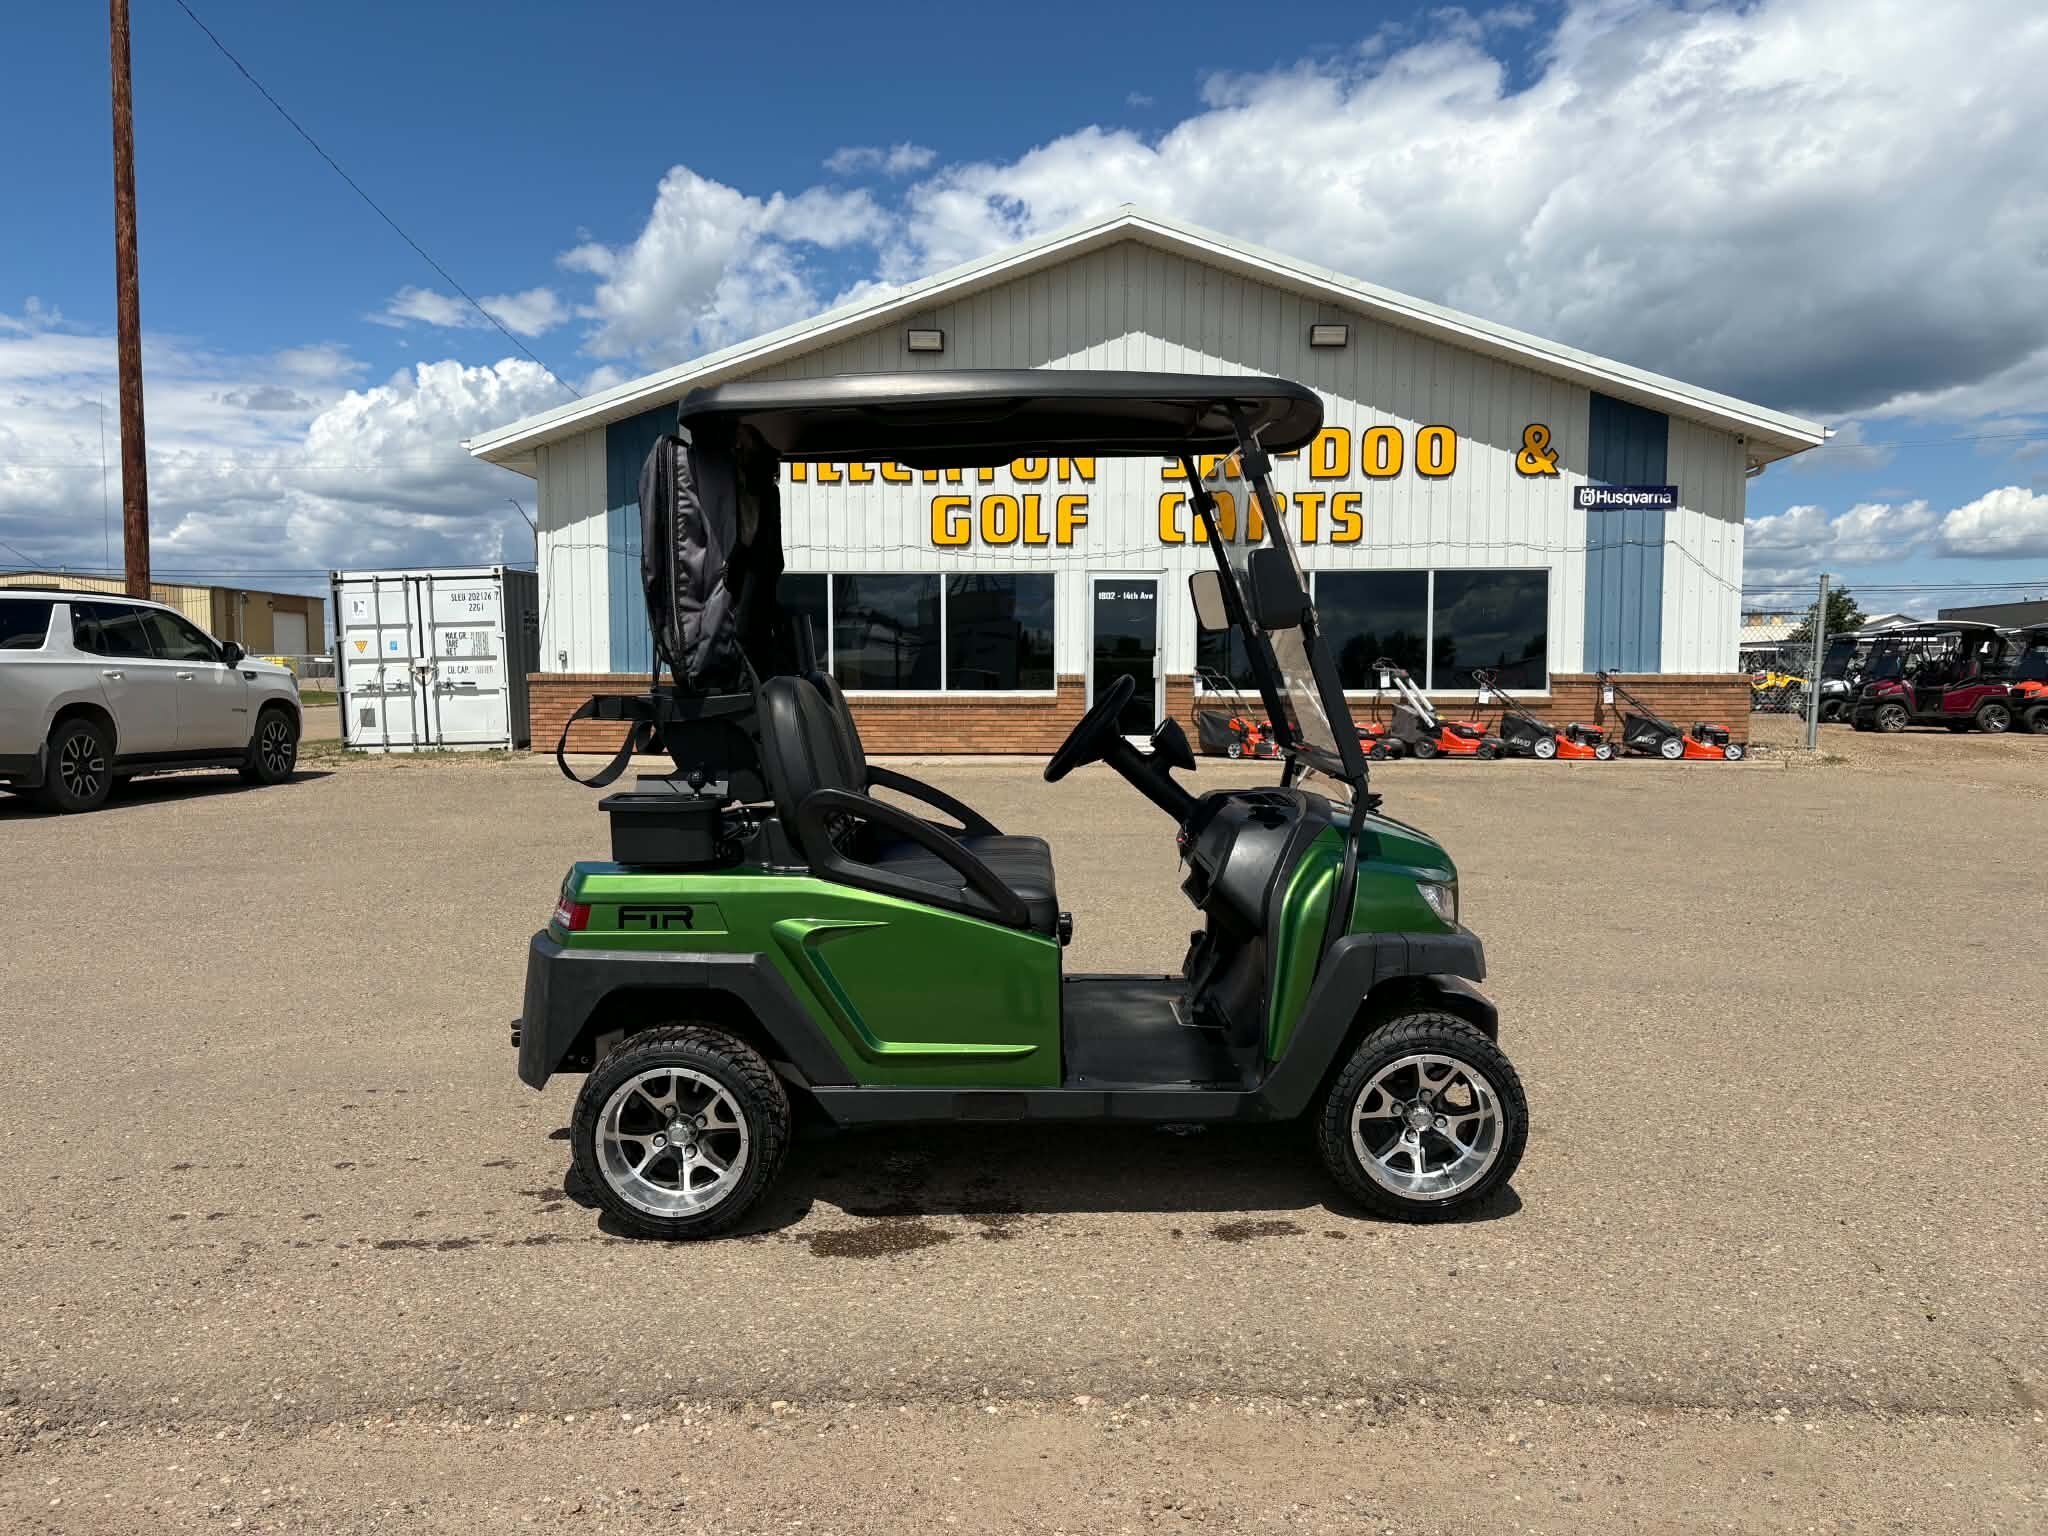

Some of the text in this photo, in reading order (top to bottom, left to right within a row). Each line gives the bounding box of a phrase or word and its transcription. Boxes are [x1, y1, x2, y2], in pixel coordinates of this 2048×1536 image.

[1516, 424, 1559, 477] &
[1596, 490, 1671, 505] Husqvarna
[931, 494, 1088, 546] GOLF
[1123, 592, 1138, 600] 14th
[1140, 592, 1154, 600] Ave
